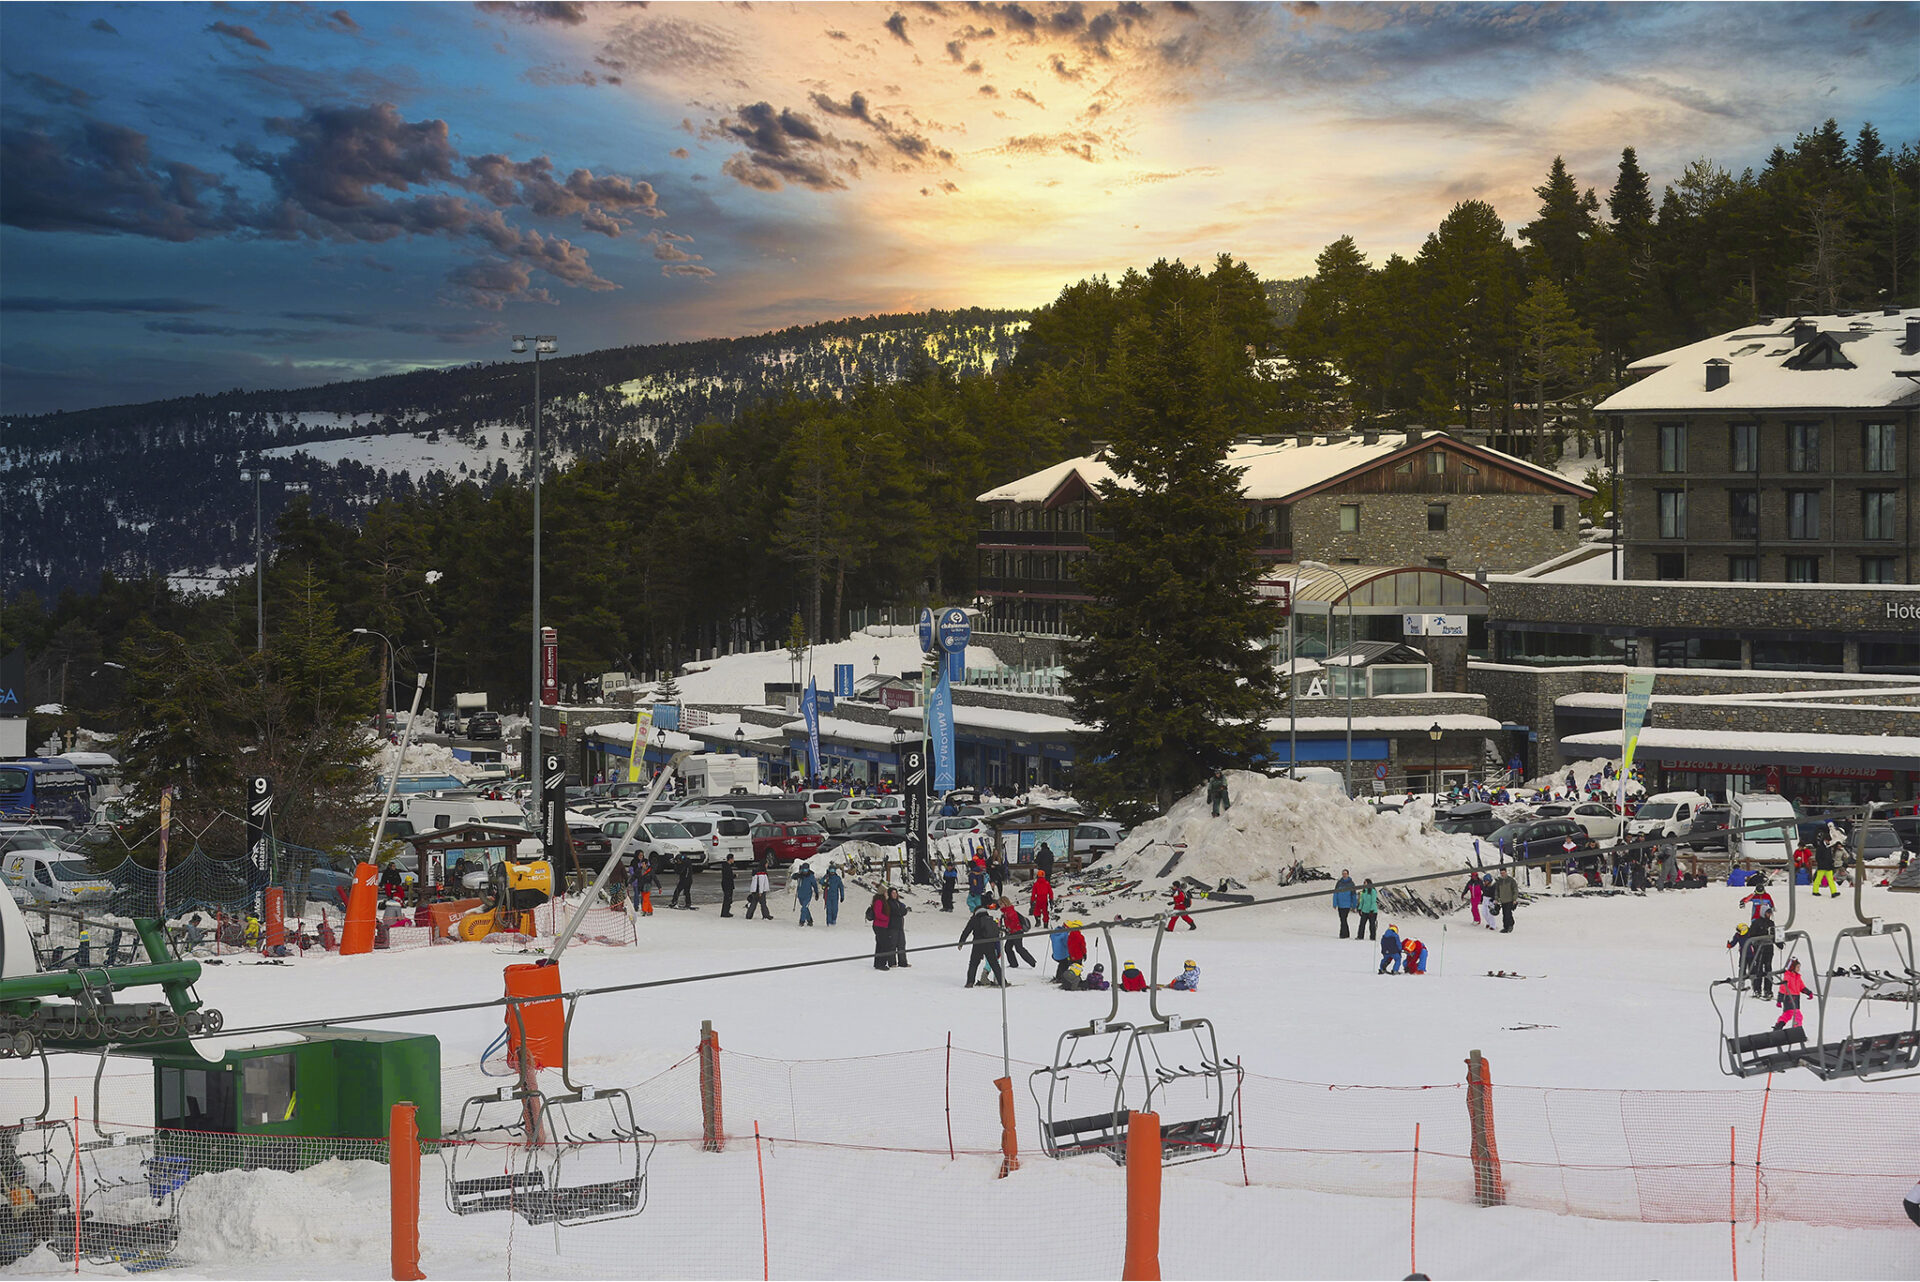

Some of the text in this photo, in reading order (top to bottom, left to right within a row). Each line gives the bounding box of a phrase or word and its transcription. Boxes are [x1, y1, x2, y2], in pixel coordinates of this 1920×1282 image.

[547, 756, 558, 771] 6
[909, 753, 919, 768] 8
[254, 777, 268, 795] 9
